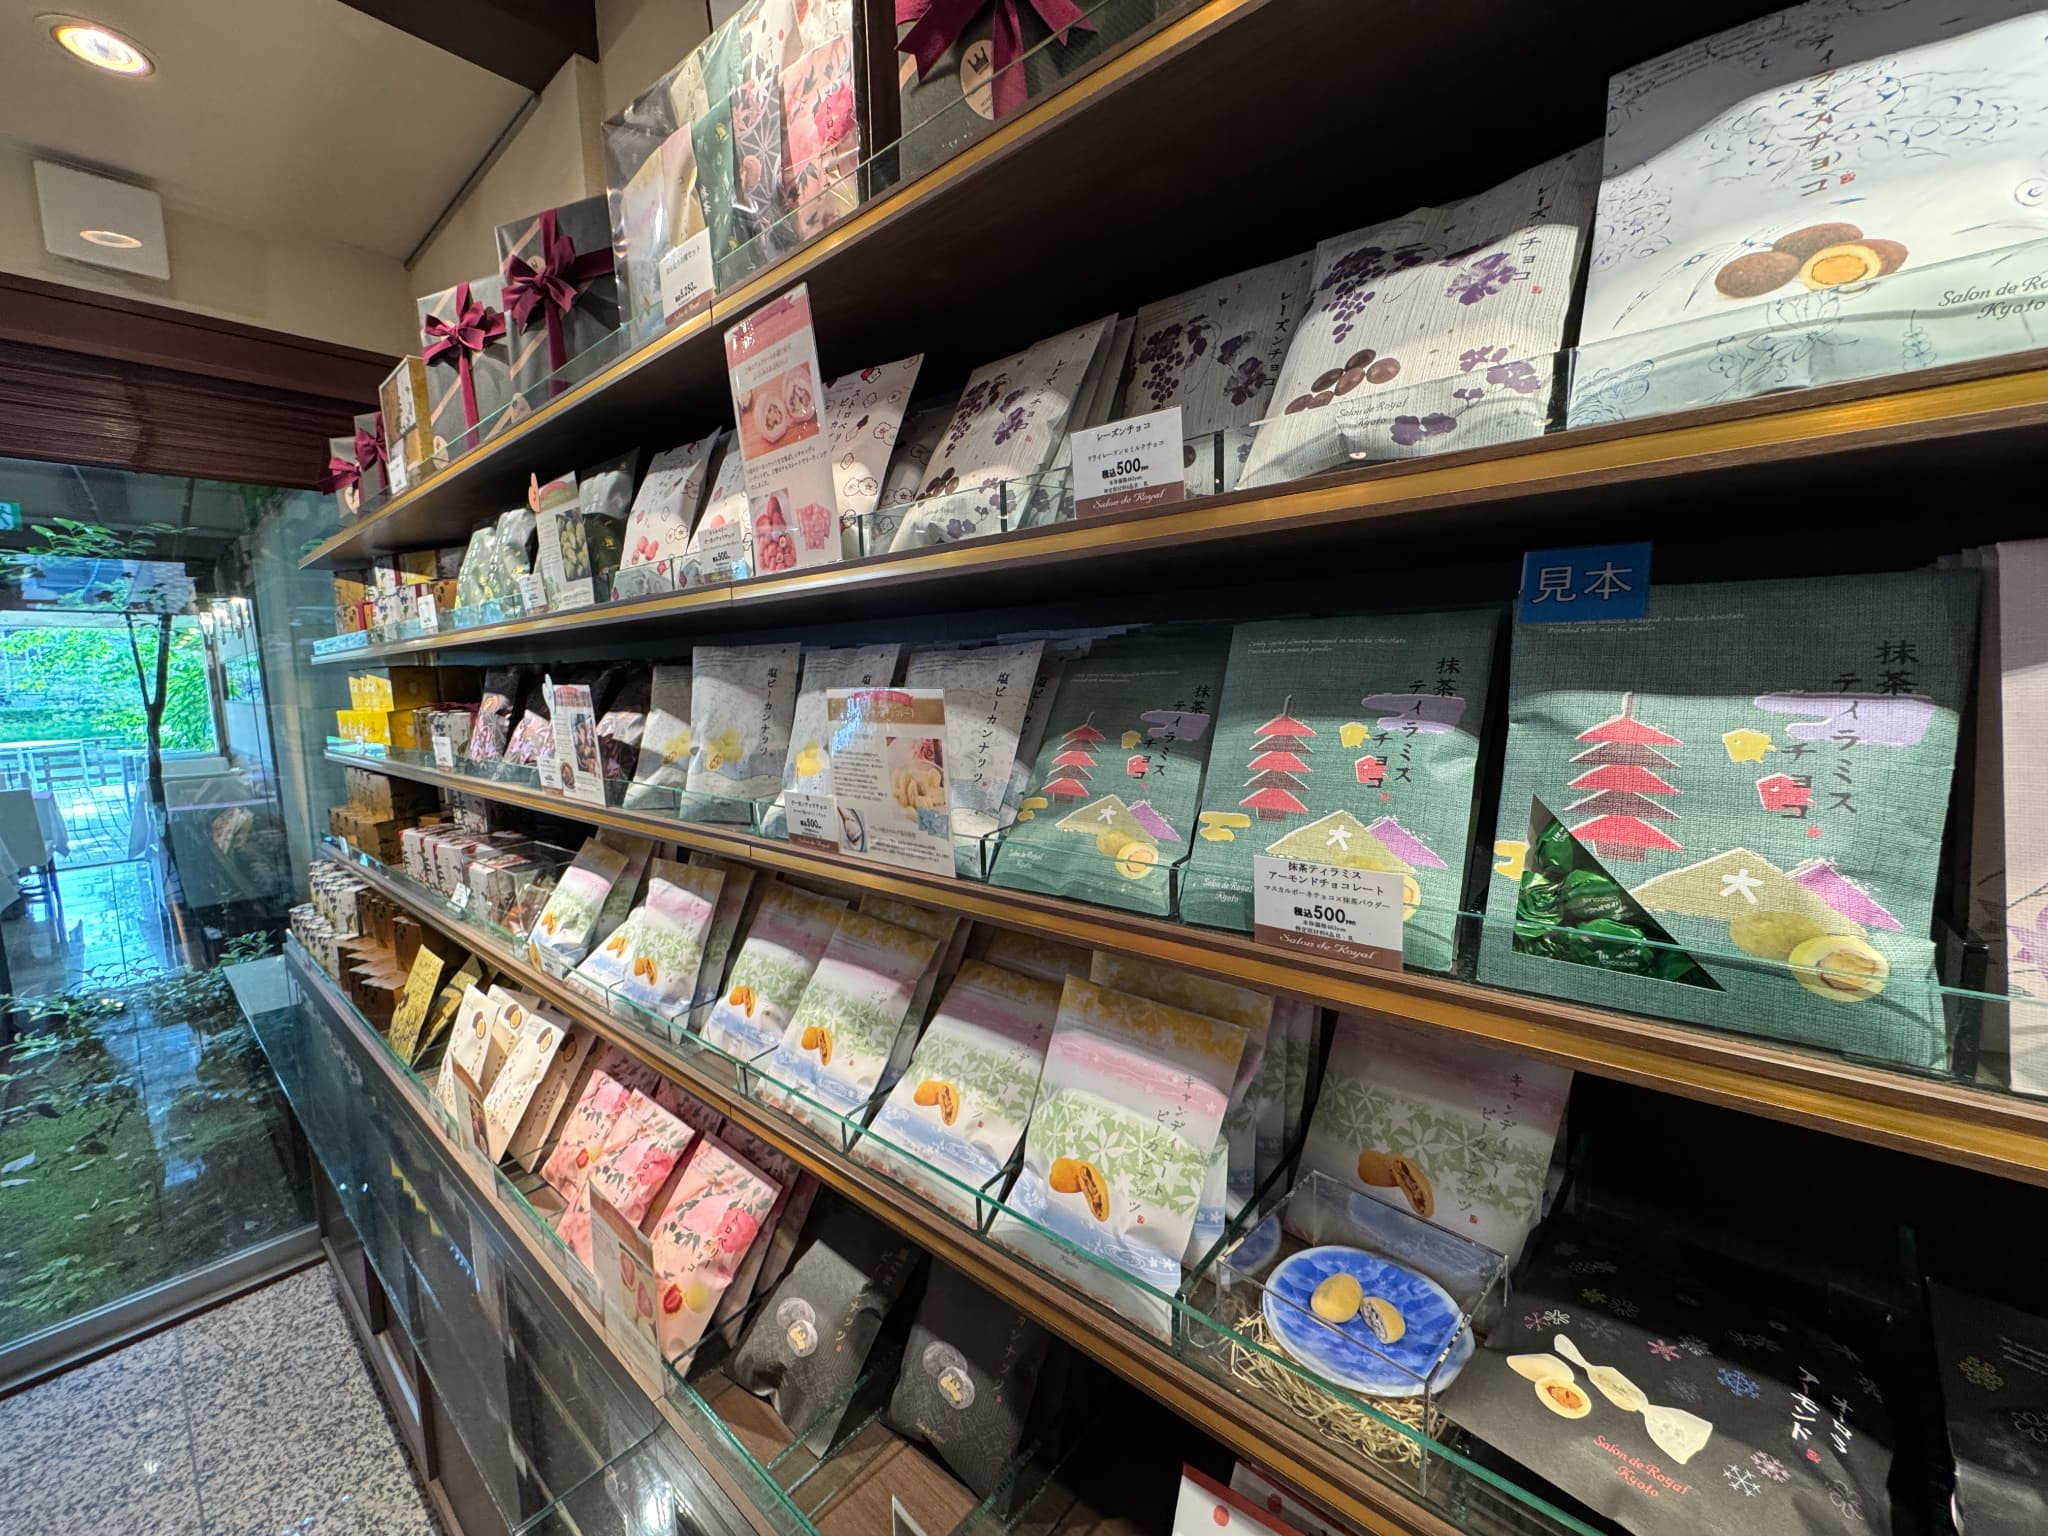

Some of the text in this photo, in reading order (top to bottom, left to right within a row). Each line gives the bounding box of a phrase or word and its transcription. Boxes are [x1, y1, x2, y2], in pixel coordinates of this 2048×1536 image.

[1513, 182, 1556, 281] レーズンチョコ
[1938, 275, 2048, 307] Salon de Ro
[1976, 298, 2047, 321] Kyoto
[1263, 291, 1294, 386] レーズンチョコ
[1096, 421, 1152, 441] レーズンチョコ
[1376, 396, 1409, 412] Royal
[1532, 561, 1633, 604] 見本
[1433, 656, 1461, 697] 抹茶
[1874, 639, 1919, 696] 抹茶
[759, 667, 779, 758] 塩ピーカンナッツ
[973, 671, 1010, 783] 塩ピーカンナッツ
[1190, 684, 1211, 715] 抹茶
[1133, 738, 1158, 780] チョコ
[1152, 700, 1186, 777] ティラミス
[1367, 731, 1393, 789] チョコ
[1394, 679, 1428, 784] ティラミス
[1830, 671, 1863, 816] ティラミス
[1781, 739, 1818, 821] チョコ
[1268, 871, 1385, 896] アーモンドチョコレート
[1287, 860, 1362, 880] 抹茶ティラミス
[1279, 933, 1377, 961] Salon de Royal
[1128, 1109, 1171, 1214] ピーカンナッツ
[1154, 1075, 1195, 1197] キャンディコート
[1487, 1072, 1523, 1197] キャンディコート
[1790, 1365, 1821, 1441] アーモンド
[1593, 1434, 1694, 1496] Salon de Royal
[1615, 1465, 1660, 1497] Kyoto
